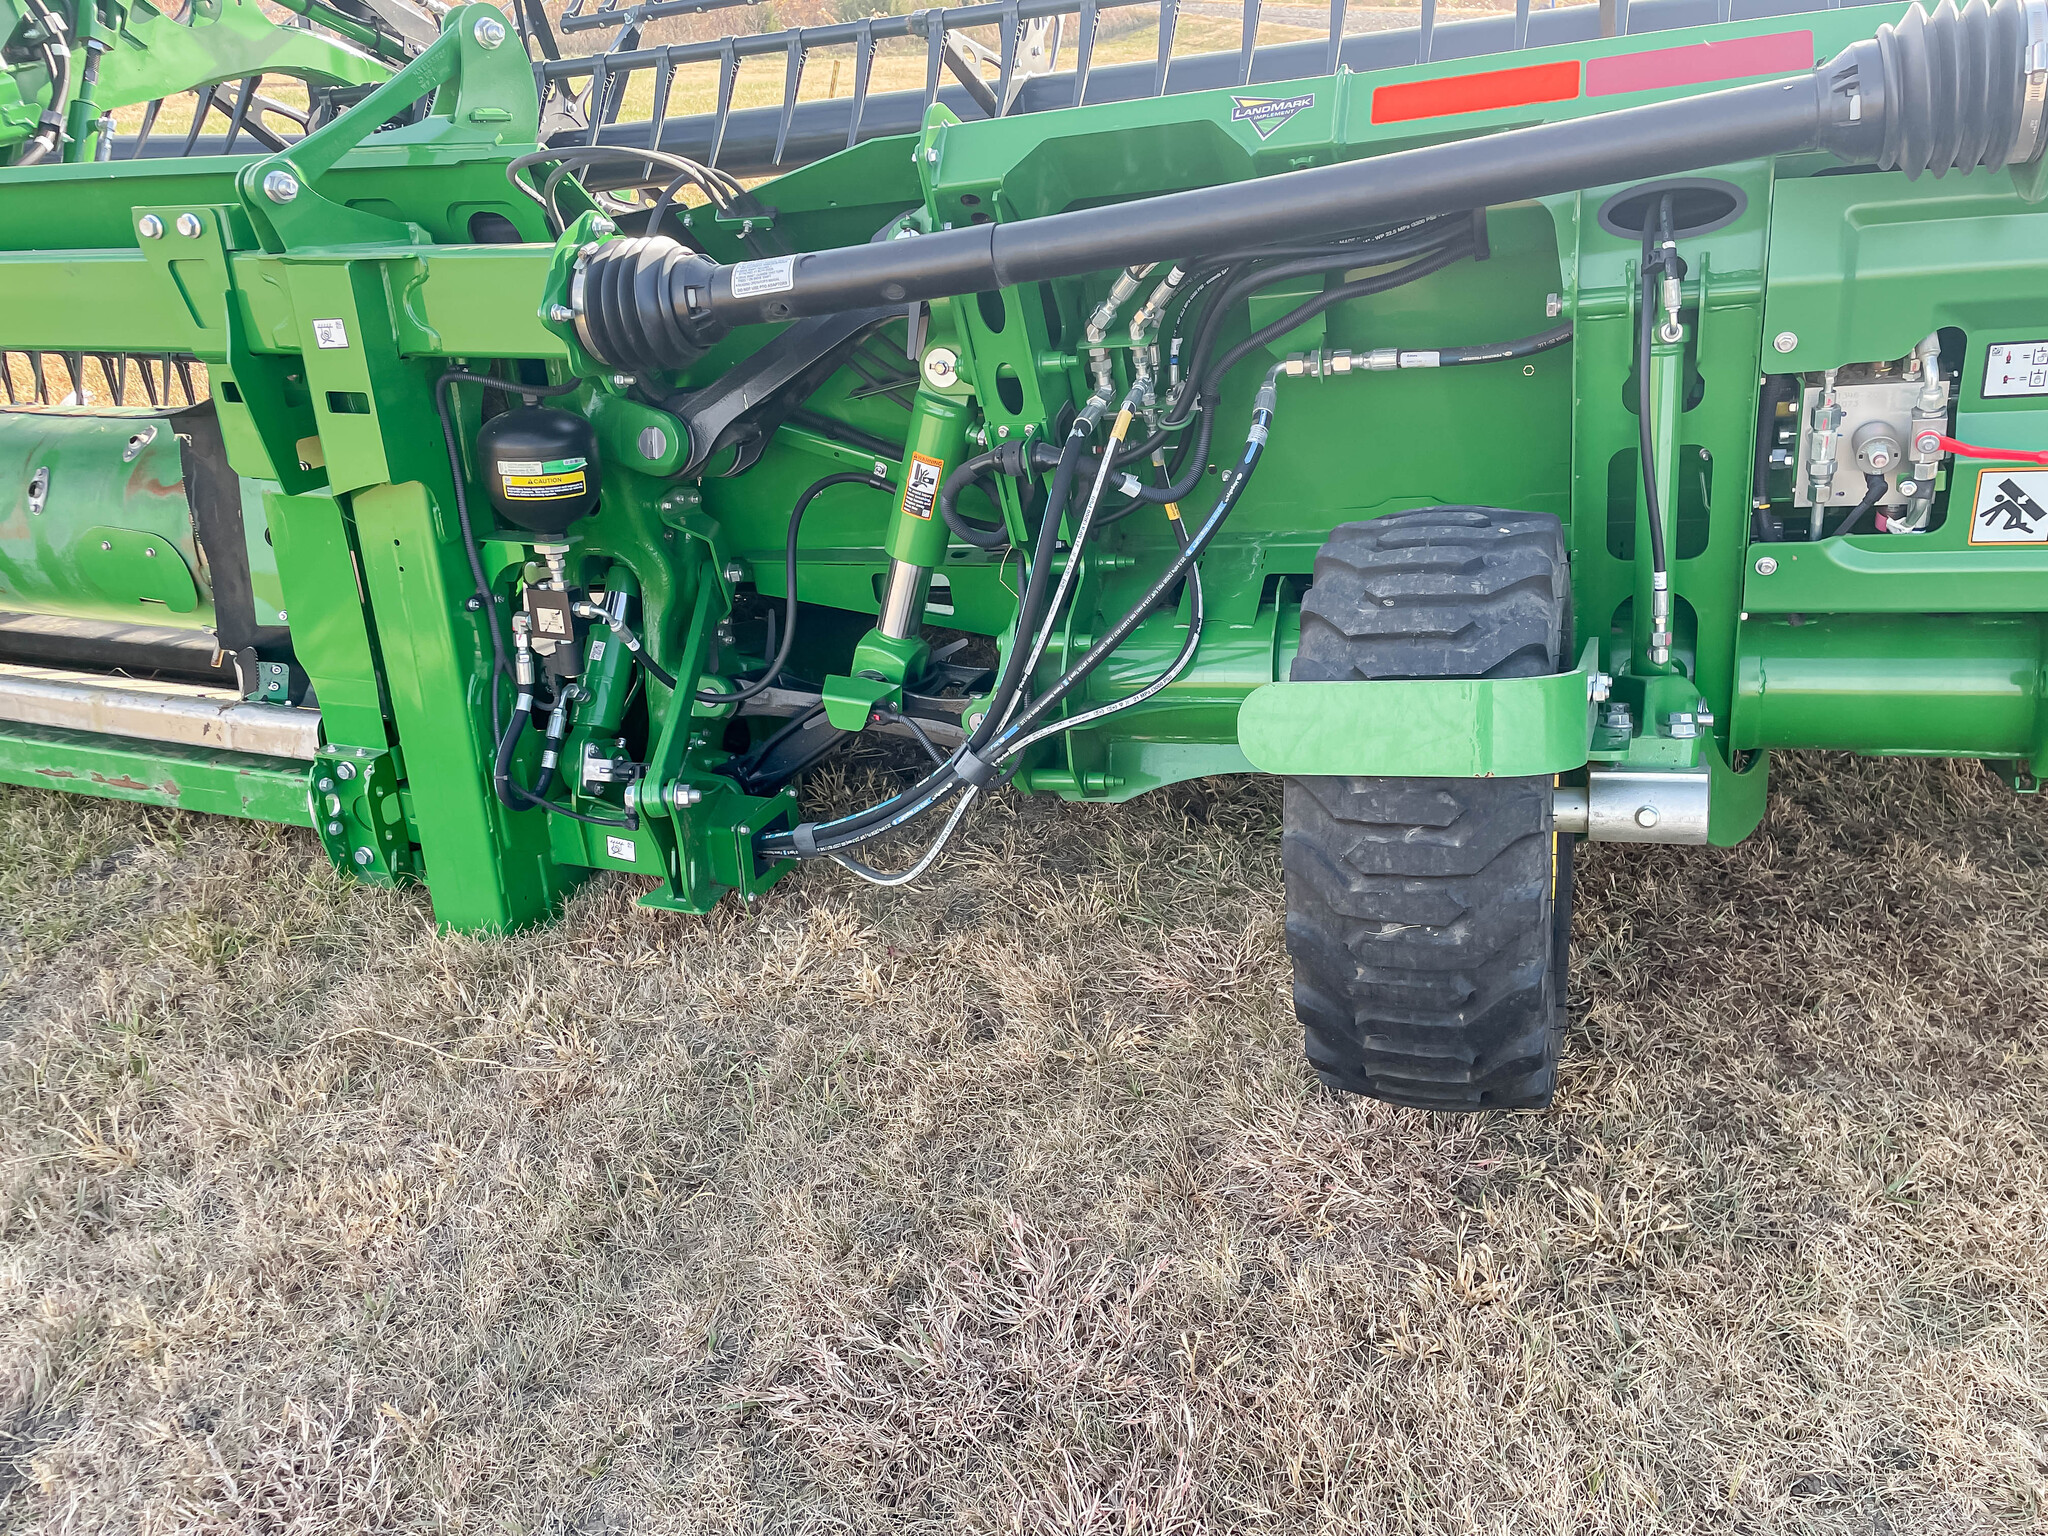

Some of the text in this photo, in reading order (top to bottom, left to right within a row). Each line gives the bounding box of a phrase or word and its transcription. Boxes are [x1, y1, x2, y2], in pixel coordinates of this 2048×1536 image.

[1254, 109, 1295, 120] IMPLEMENT
[533, 477, 562, 485] CAUTION
[1139, 689, 1150, 699] MPa
